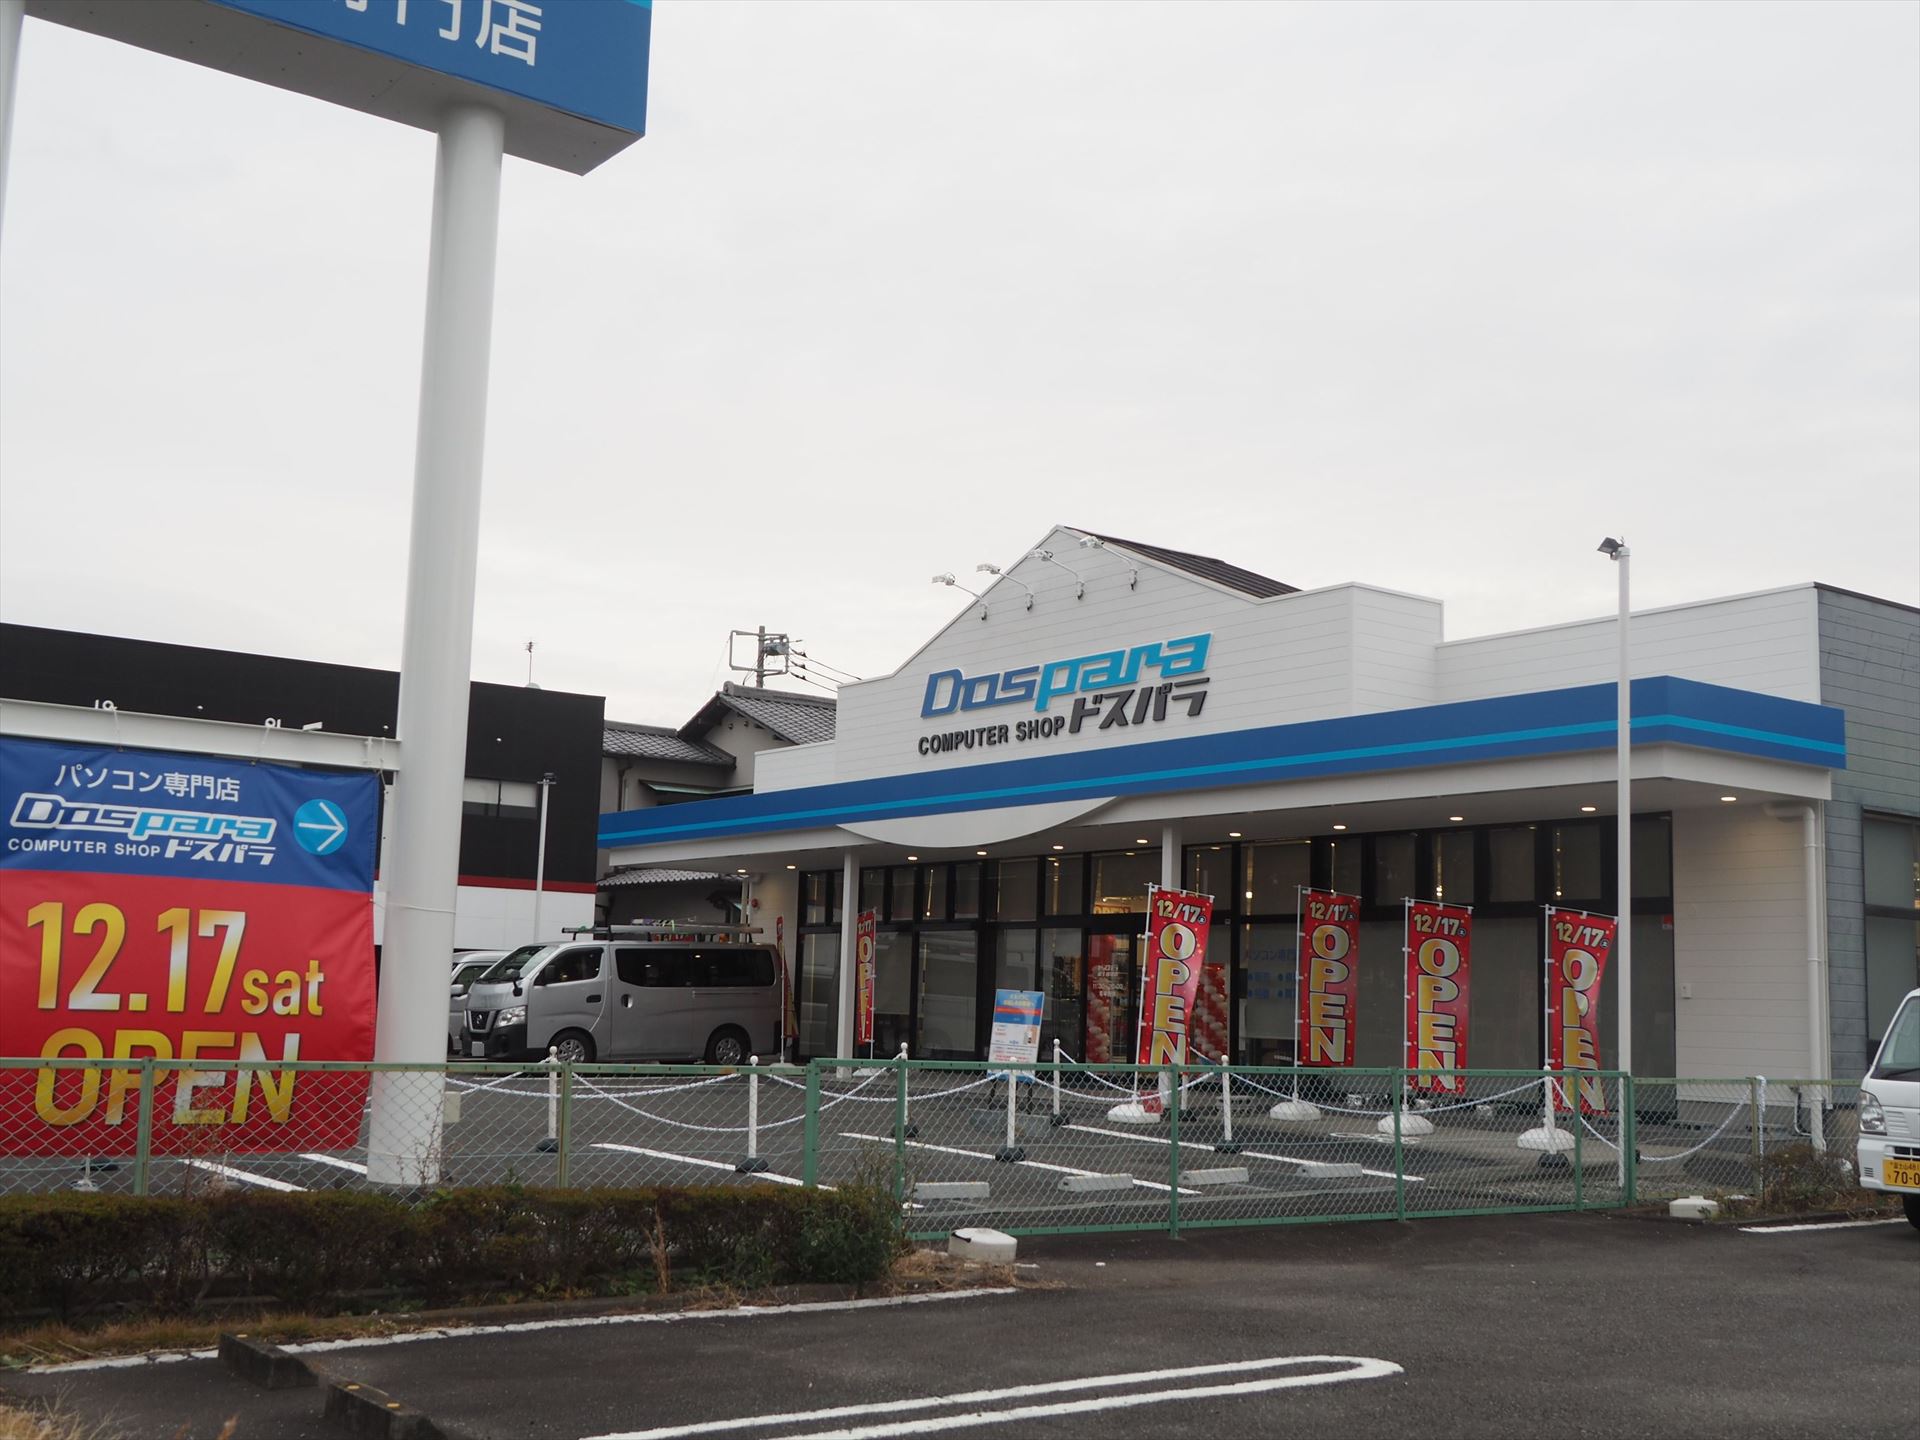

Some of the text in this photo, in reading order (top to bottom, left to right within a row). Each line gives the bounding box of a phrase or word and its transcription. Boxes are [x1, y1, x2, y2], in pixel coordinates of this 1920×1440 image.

[918, 677, 1210, 755] COMPUTER SHOP ドスパラ
[920, 632, 1213, 719] Dospara
[10, 792, 277, 842] Dospara
[54, 764, 240, 802] パソコン専門店
[8, 838, 276, 865] COMPUTER SHOP ドスパラ
[27, 902, 325, 1016] 12.17 sat
[1150, 922, 1197, 1065] OPEN
[1309, 924, 1350, 1063] OPEN
[1417, 938, 1461, 1091] OPEN
[1562, 948, 1606, 1112] OPEN
[33, 1027, 301, 1127] OPEN
